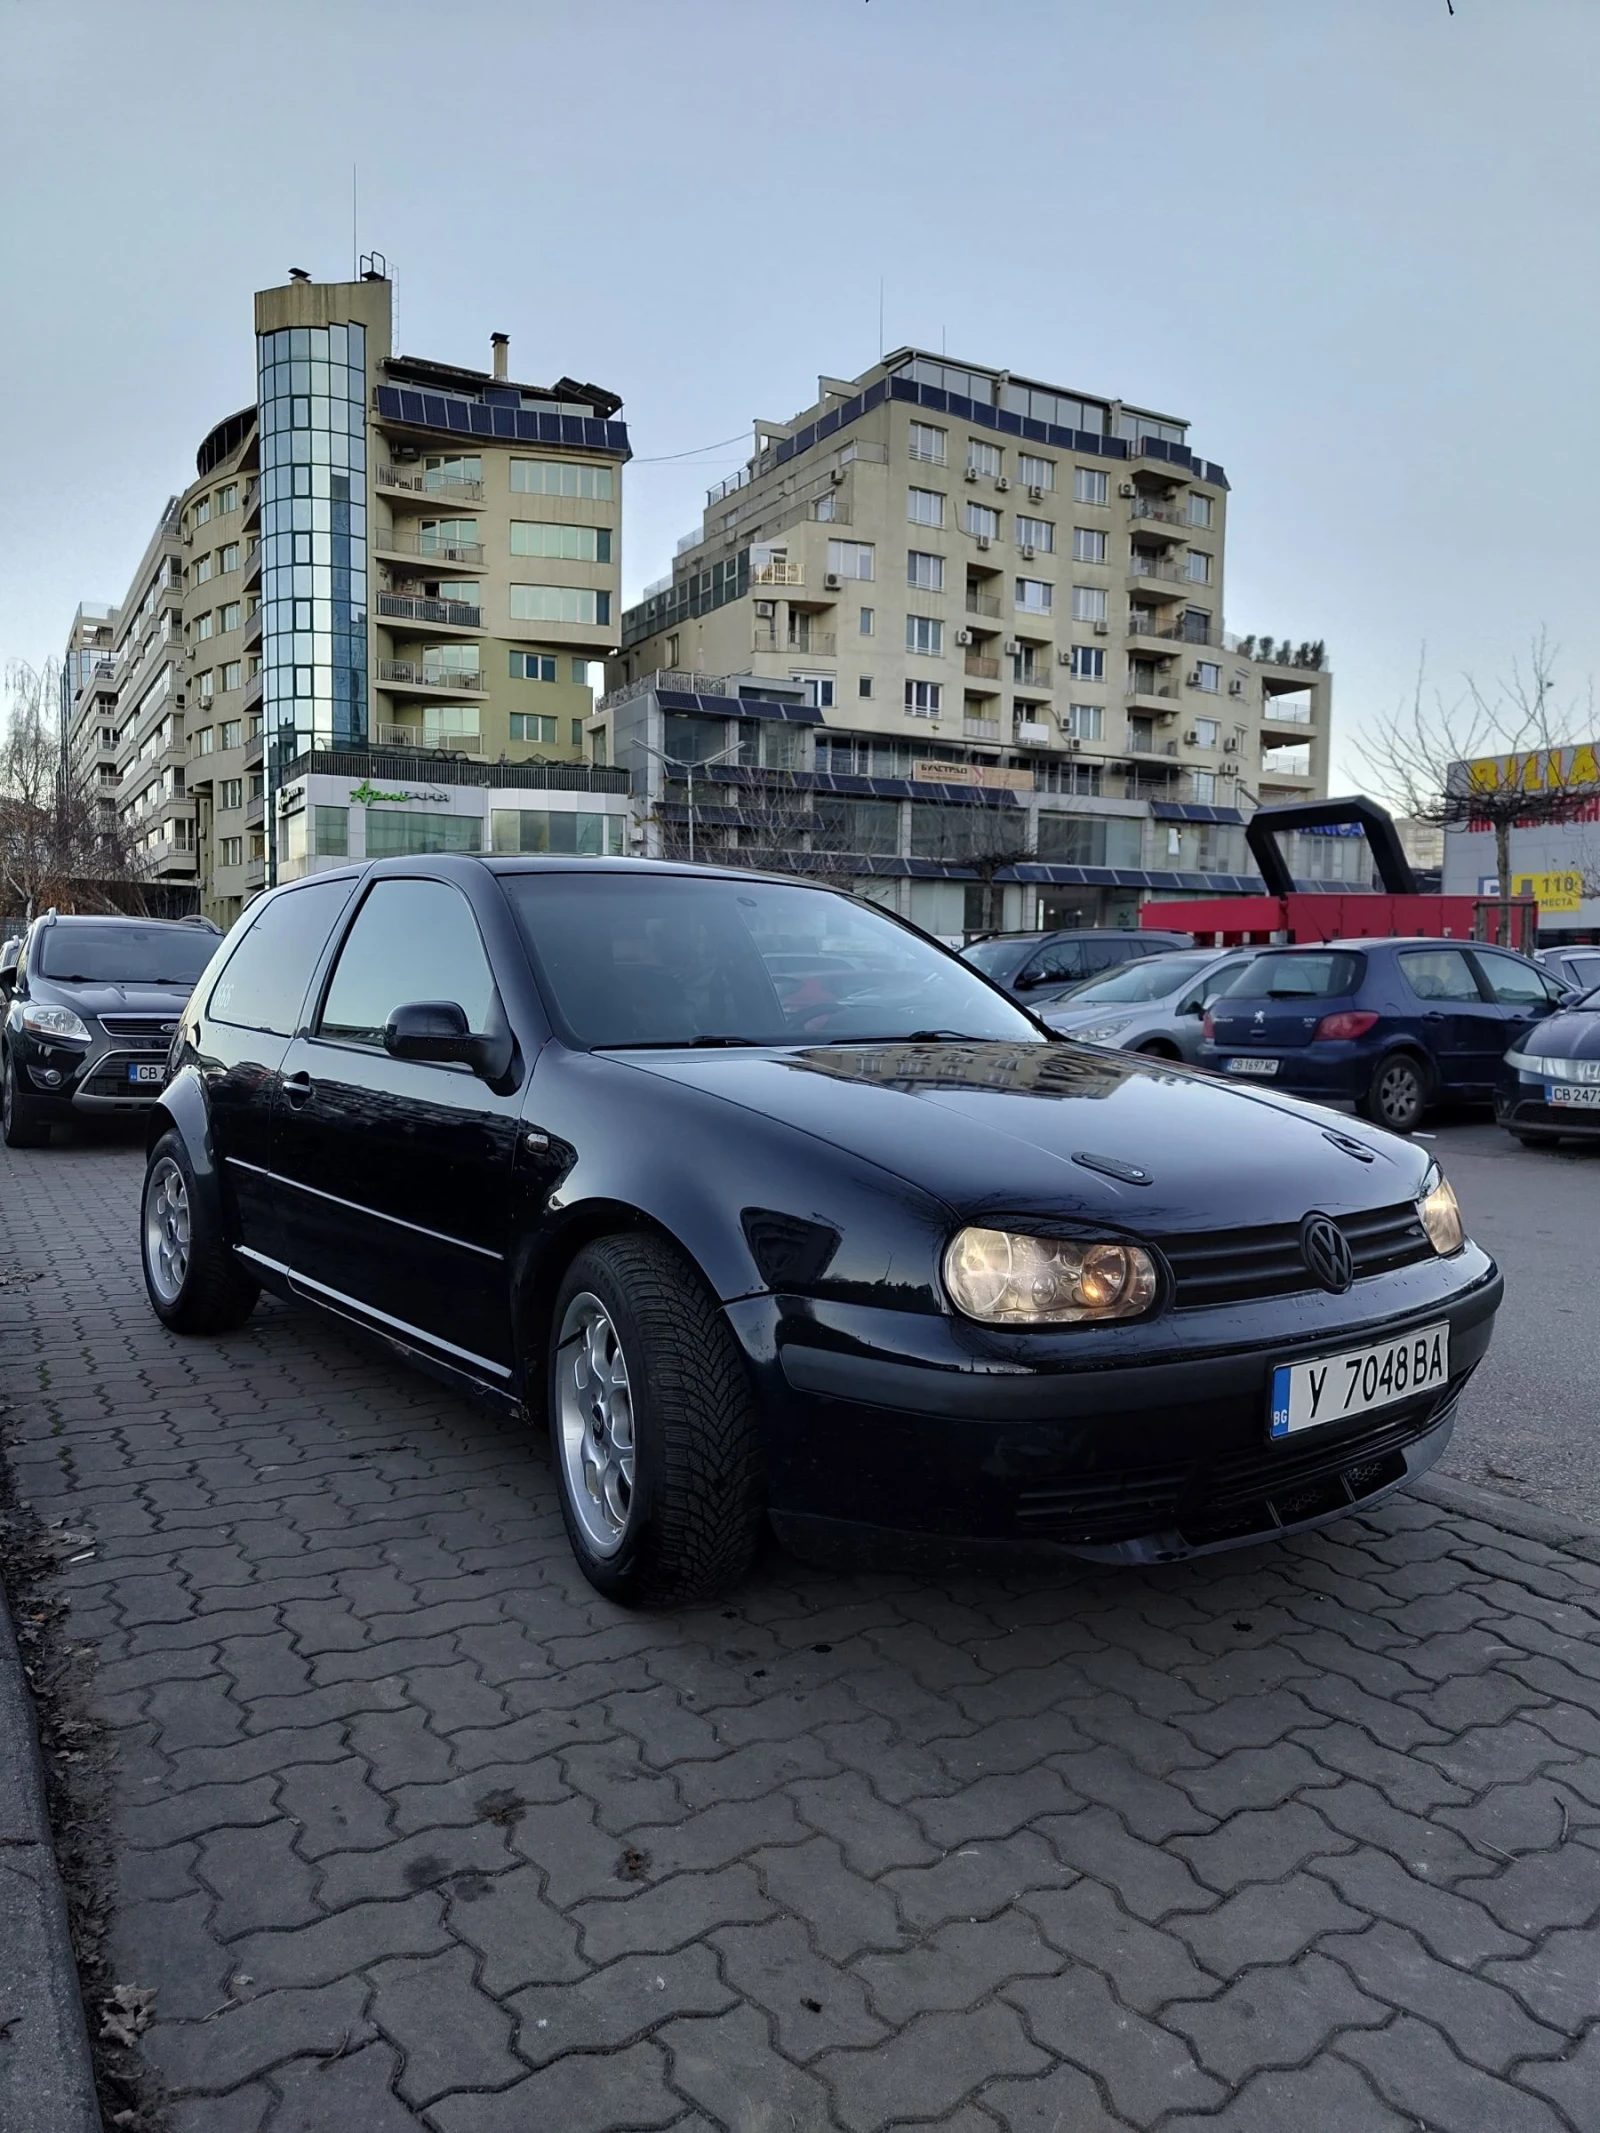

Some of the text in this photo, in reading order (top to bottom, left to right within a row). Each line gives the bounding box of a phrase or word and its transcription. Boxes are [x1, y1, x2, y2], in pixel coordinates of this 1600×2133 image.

[1471, 746, 1600, 792] BILLA
[1542, 876, 1574, 893] 110
[1541, 898, 1573, 907] МЕСТА
[1244, 1060, 1265, 1070] 1697
[139, 1066, 157, 1080] CB
[1554, 1088, 1600, 1102] CB 247
[1309, 1333, 1443, 1418] Y 7048 BA
[1273, 1409, 1288, 1426] BG
